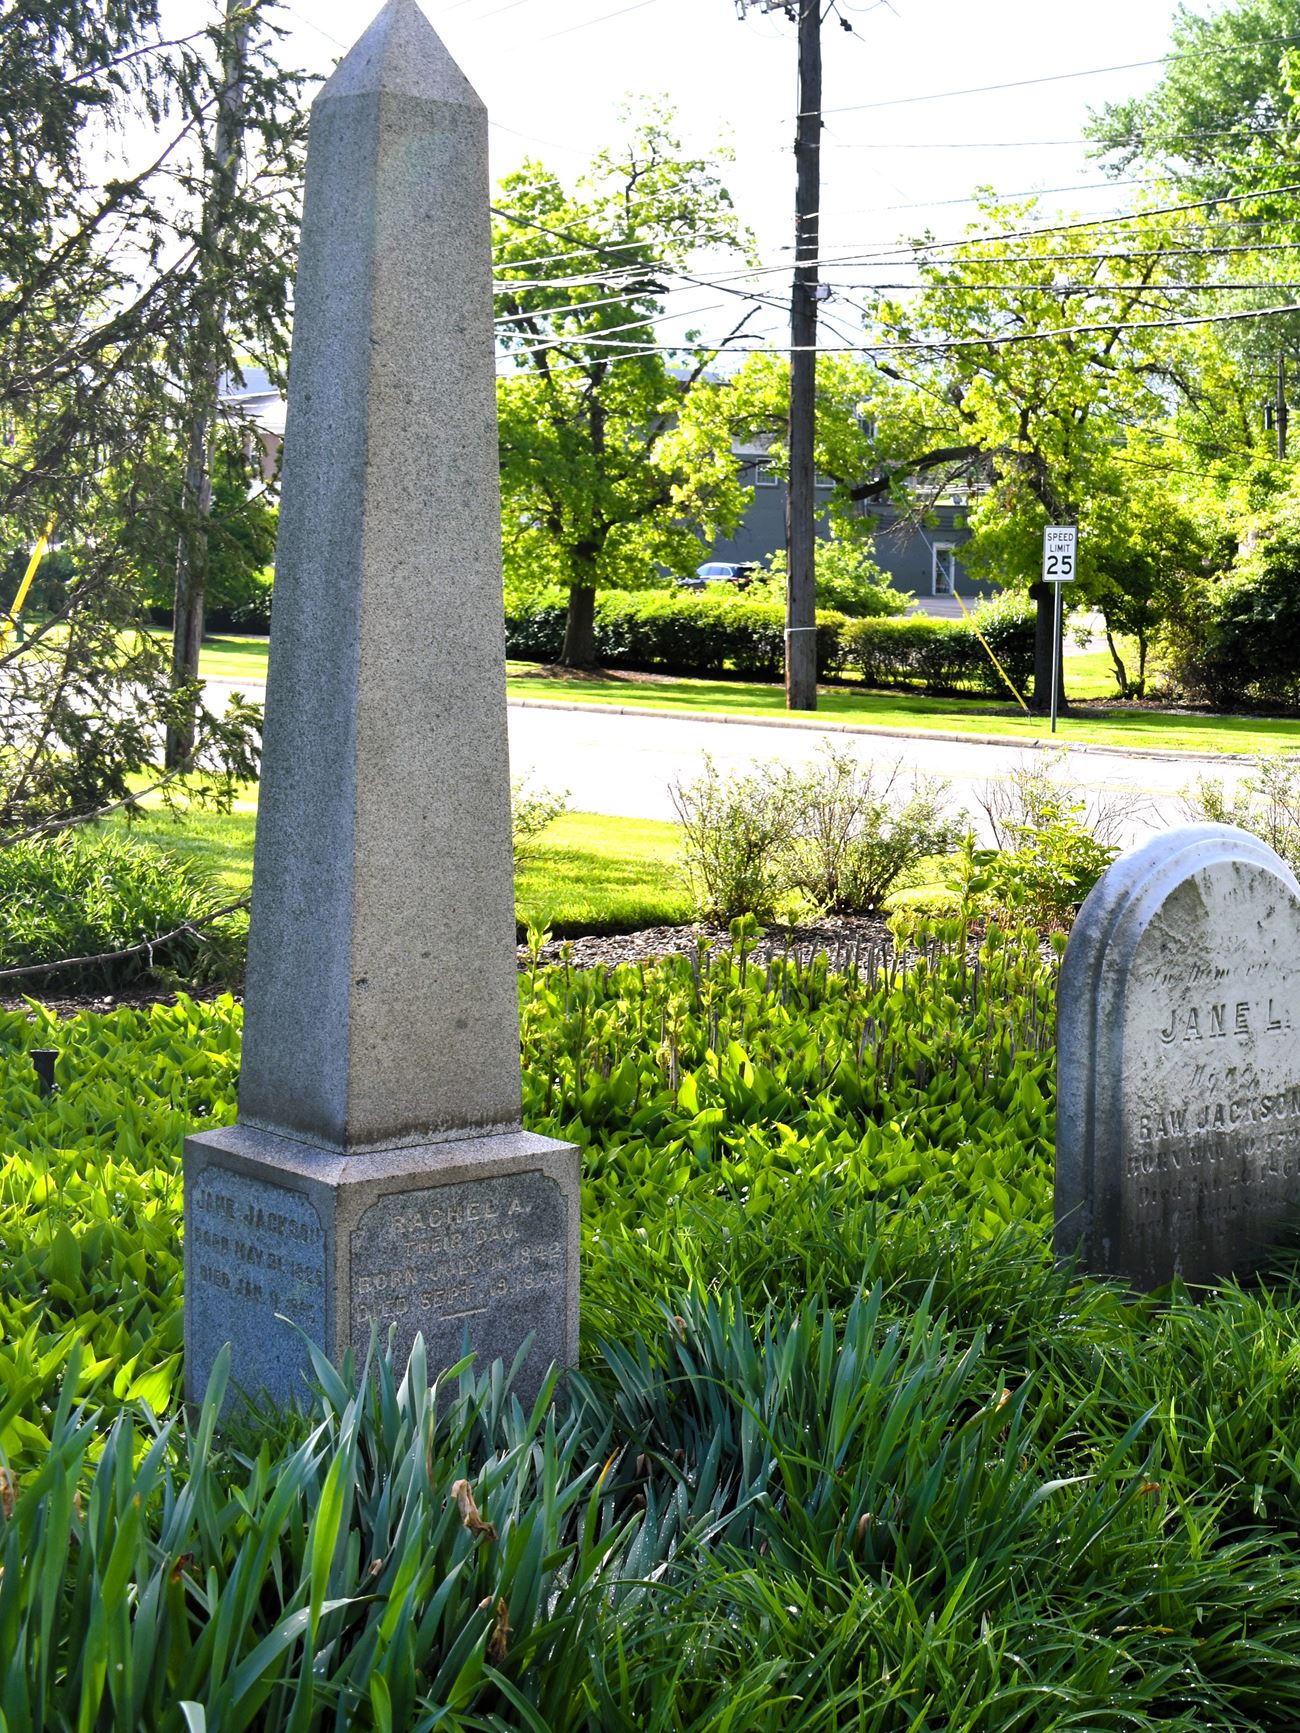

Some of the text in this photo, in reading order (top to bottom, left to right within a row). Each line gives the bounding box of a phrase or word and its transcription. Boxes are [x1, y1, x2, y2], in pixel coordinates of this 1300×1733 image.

[1047, 532, 1074, 542] SPEED
[1049, 543, 1071, 553] LIMIT
[1046, 555, 1072, 575] 25
[1159, 997, 1292, 1045] JANE L.
[196, 1188, 321, 1244] JANE JACKSON
[392, 1198, 500, 1234] RACHEL
[358, 1265, 419, 1295] BORN
[357, 1296, 410, 1323] DIED
